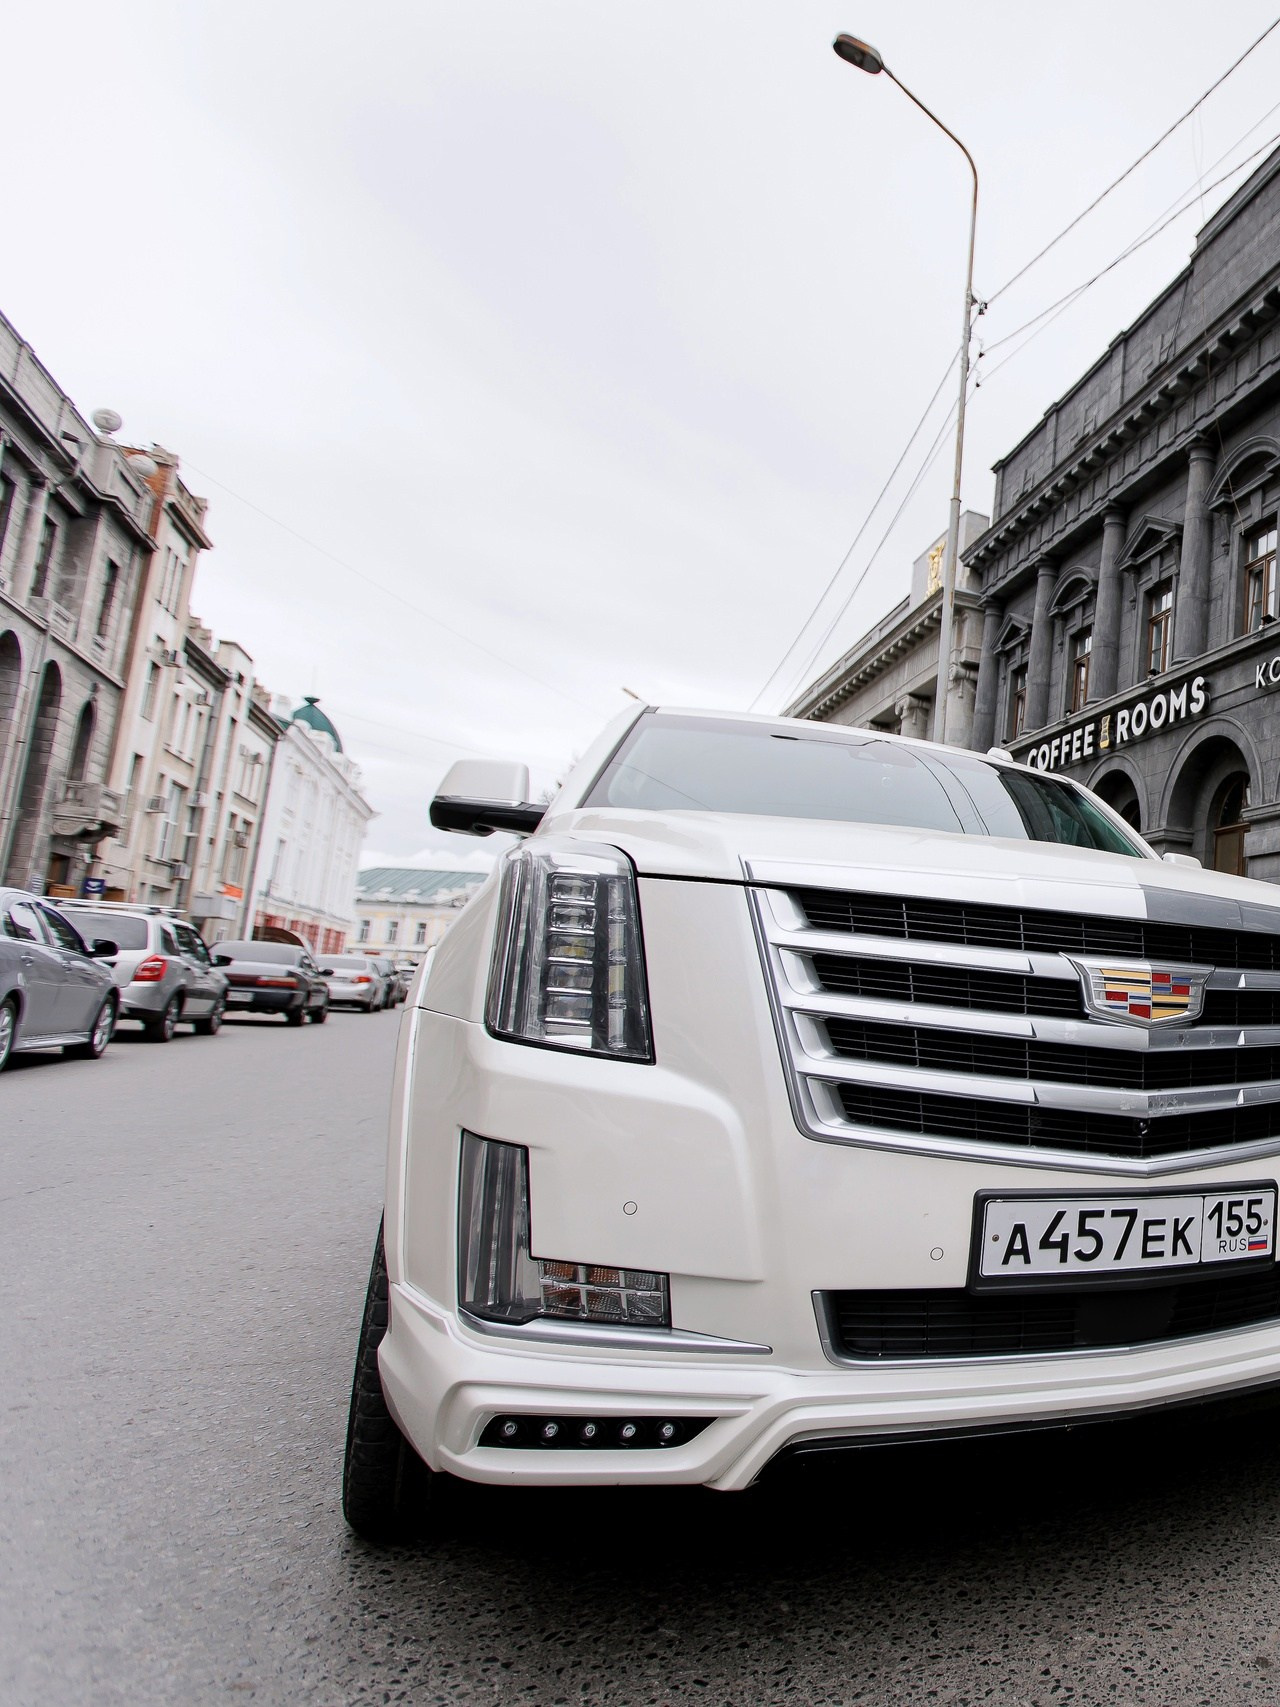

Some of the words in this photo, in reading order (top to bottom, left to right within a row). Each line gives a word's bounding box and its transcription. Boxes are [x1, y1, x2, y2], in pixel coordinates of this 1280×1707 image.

[1026, 722, 1095, 771] COFFEE
[1116, 676, 1207, 744] ROOMS
[1207, 1198, 1264, 1239] 155
[1218, 1238, 1247, 1254] RUS
